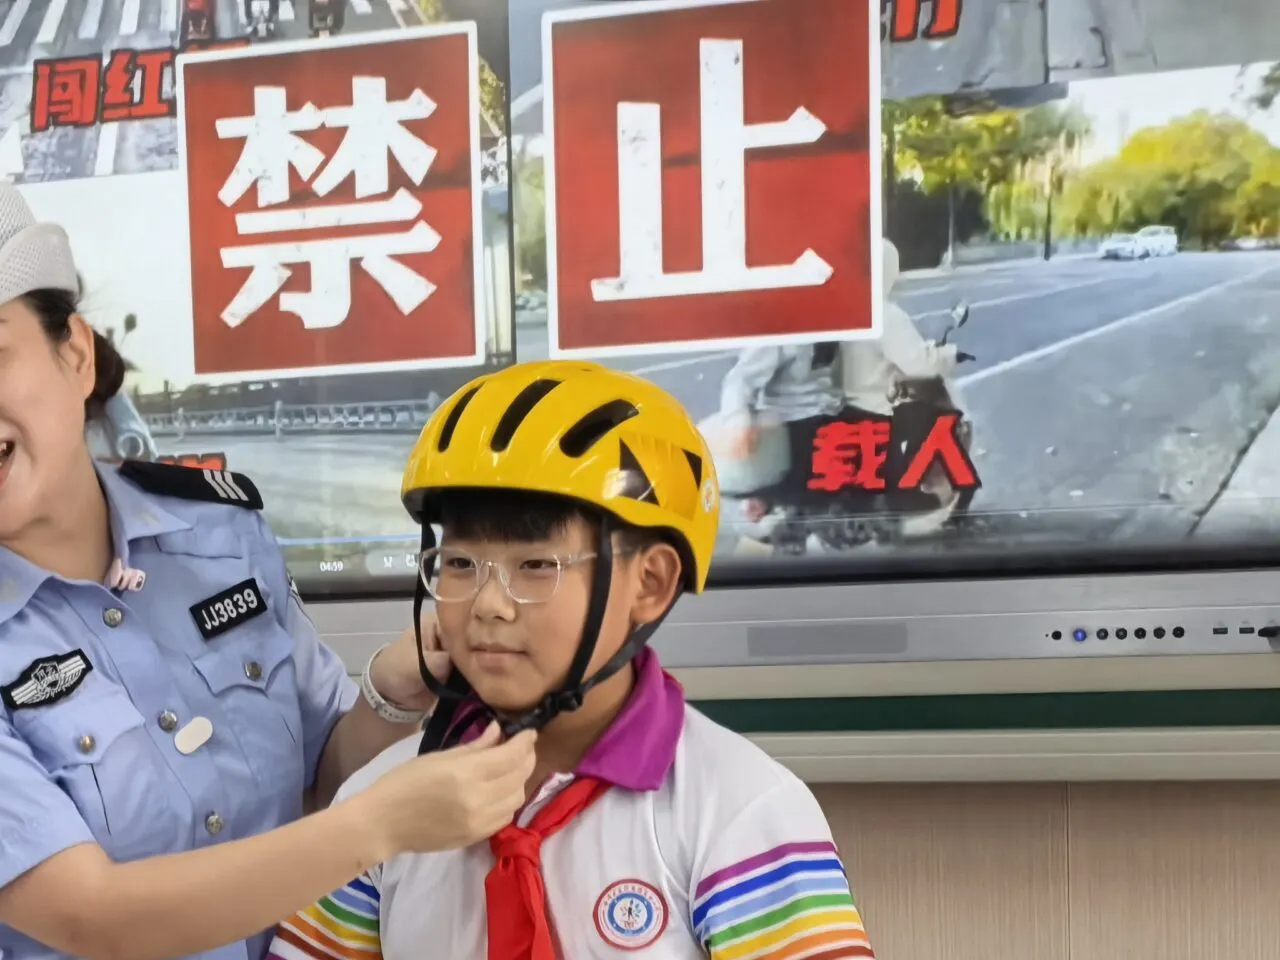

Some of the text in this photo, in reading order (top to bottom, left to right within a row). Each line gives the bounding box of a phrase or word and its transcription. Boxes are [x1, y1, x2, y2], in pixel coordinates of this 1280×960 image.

[33, 46, 196, 130] 闯红
[215, 38, 834, 329] 禁止
[806, 415, 977, 491] 载人
[201, 588, 258, 630] JJ3839
